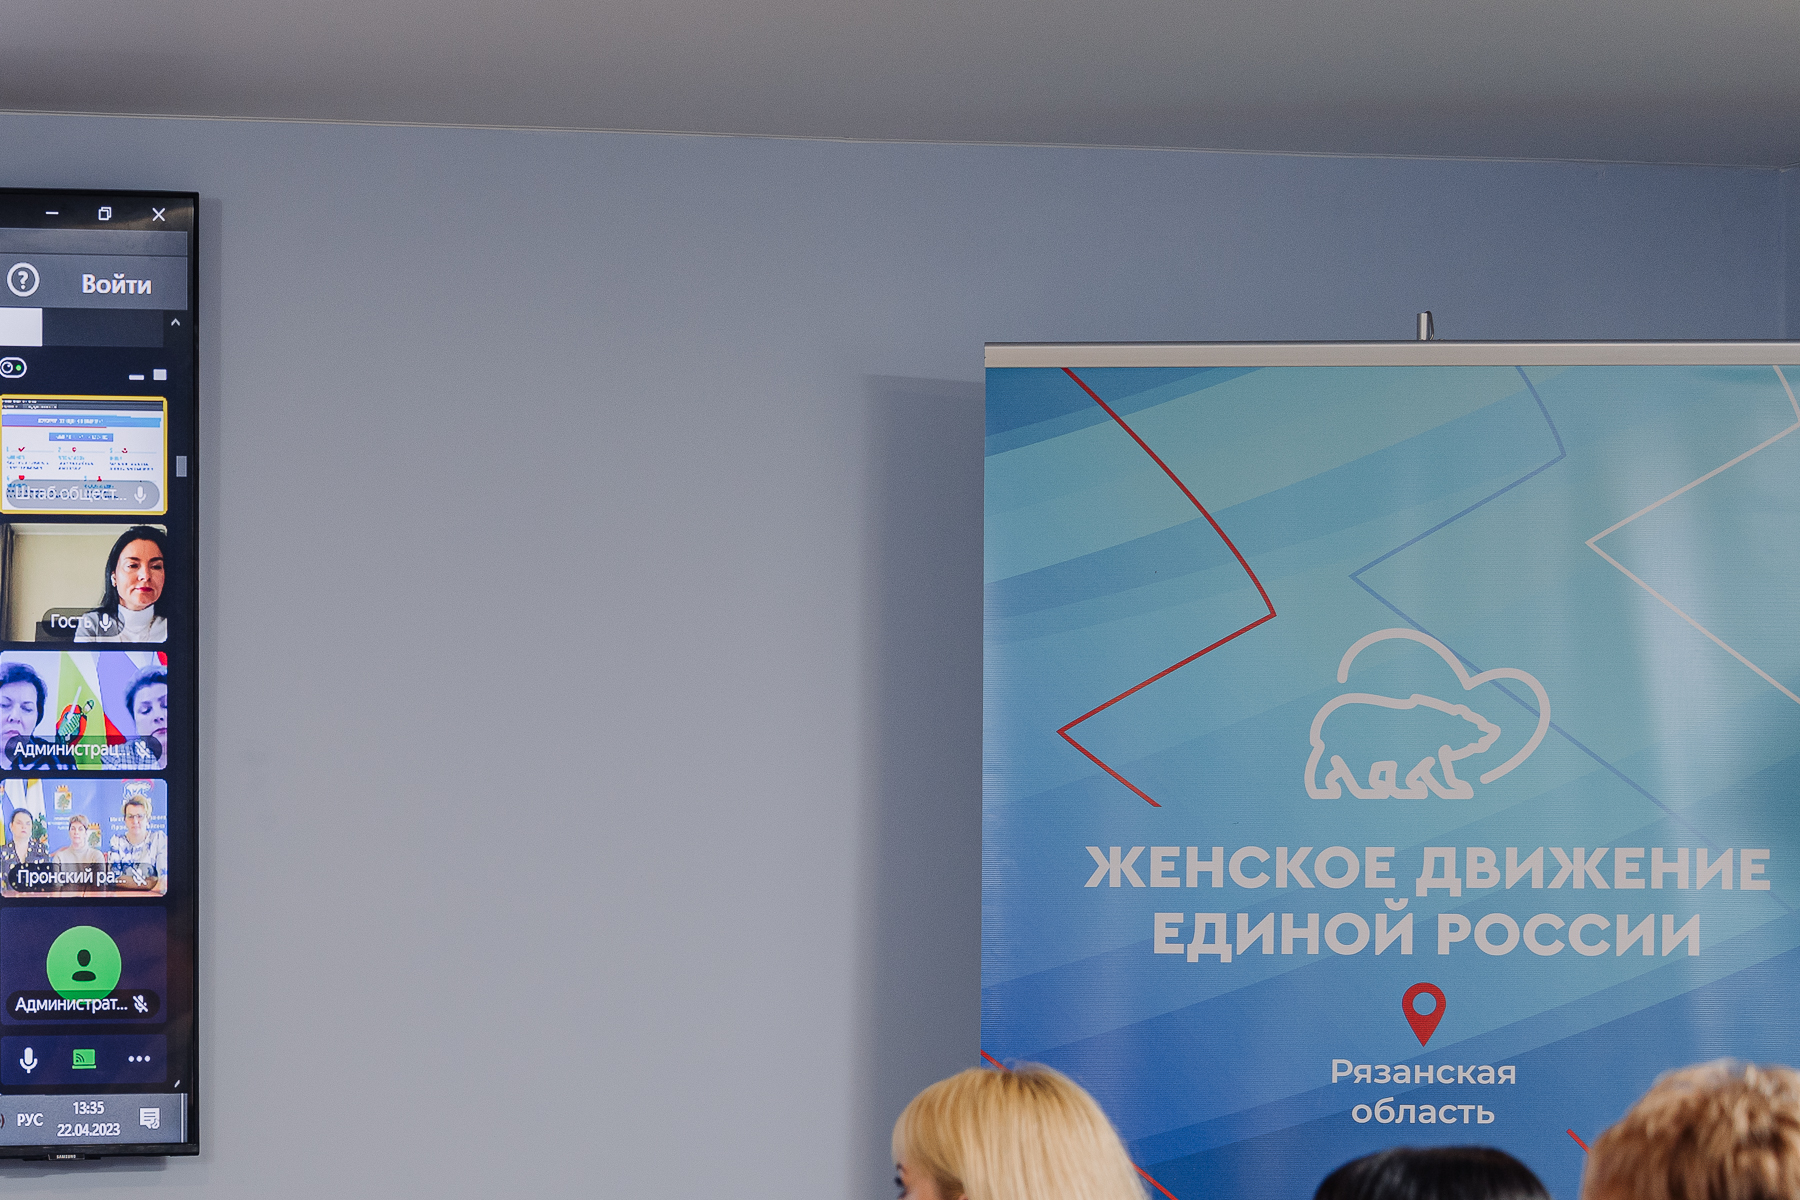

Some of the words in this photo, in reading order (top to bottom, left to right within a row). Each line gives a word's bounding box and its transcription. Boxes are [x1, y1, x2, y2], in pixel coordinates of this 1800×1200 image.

[82, 273, 152, 295] Войти
[16, 486, 55, 500] Штаб
[51, 614, 92, 629] Гость
[14, 742, 130, 759] Администрац...
[17, 869, 93, 886] Пронский
[97, 872, 126, 887] ра...
[1082, 845, 1396, 889] ЖЕНСКОЕ
[1415, 846, 1771, 898] ДВИЖЕНИЕ
[1152, 897, 1414, 963] ЕДИНОЙ
[1436, 912, 1705, 957] РОССИИ
[15, 997, 128, 1014] Администрат...
[1331, 1058, 1516, 1085] Рязанская
[72, 1101, 105, 1116] 13:35
[1351, 1096, 1495, 1124] область
[17, 1111, 44, 1128] РУС
[55, 1122, 121, 1138] 22.04.2023
